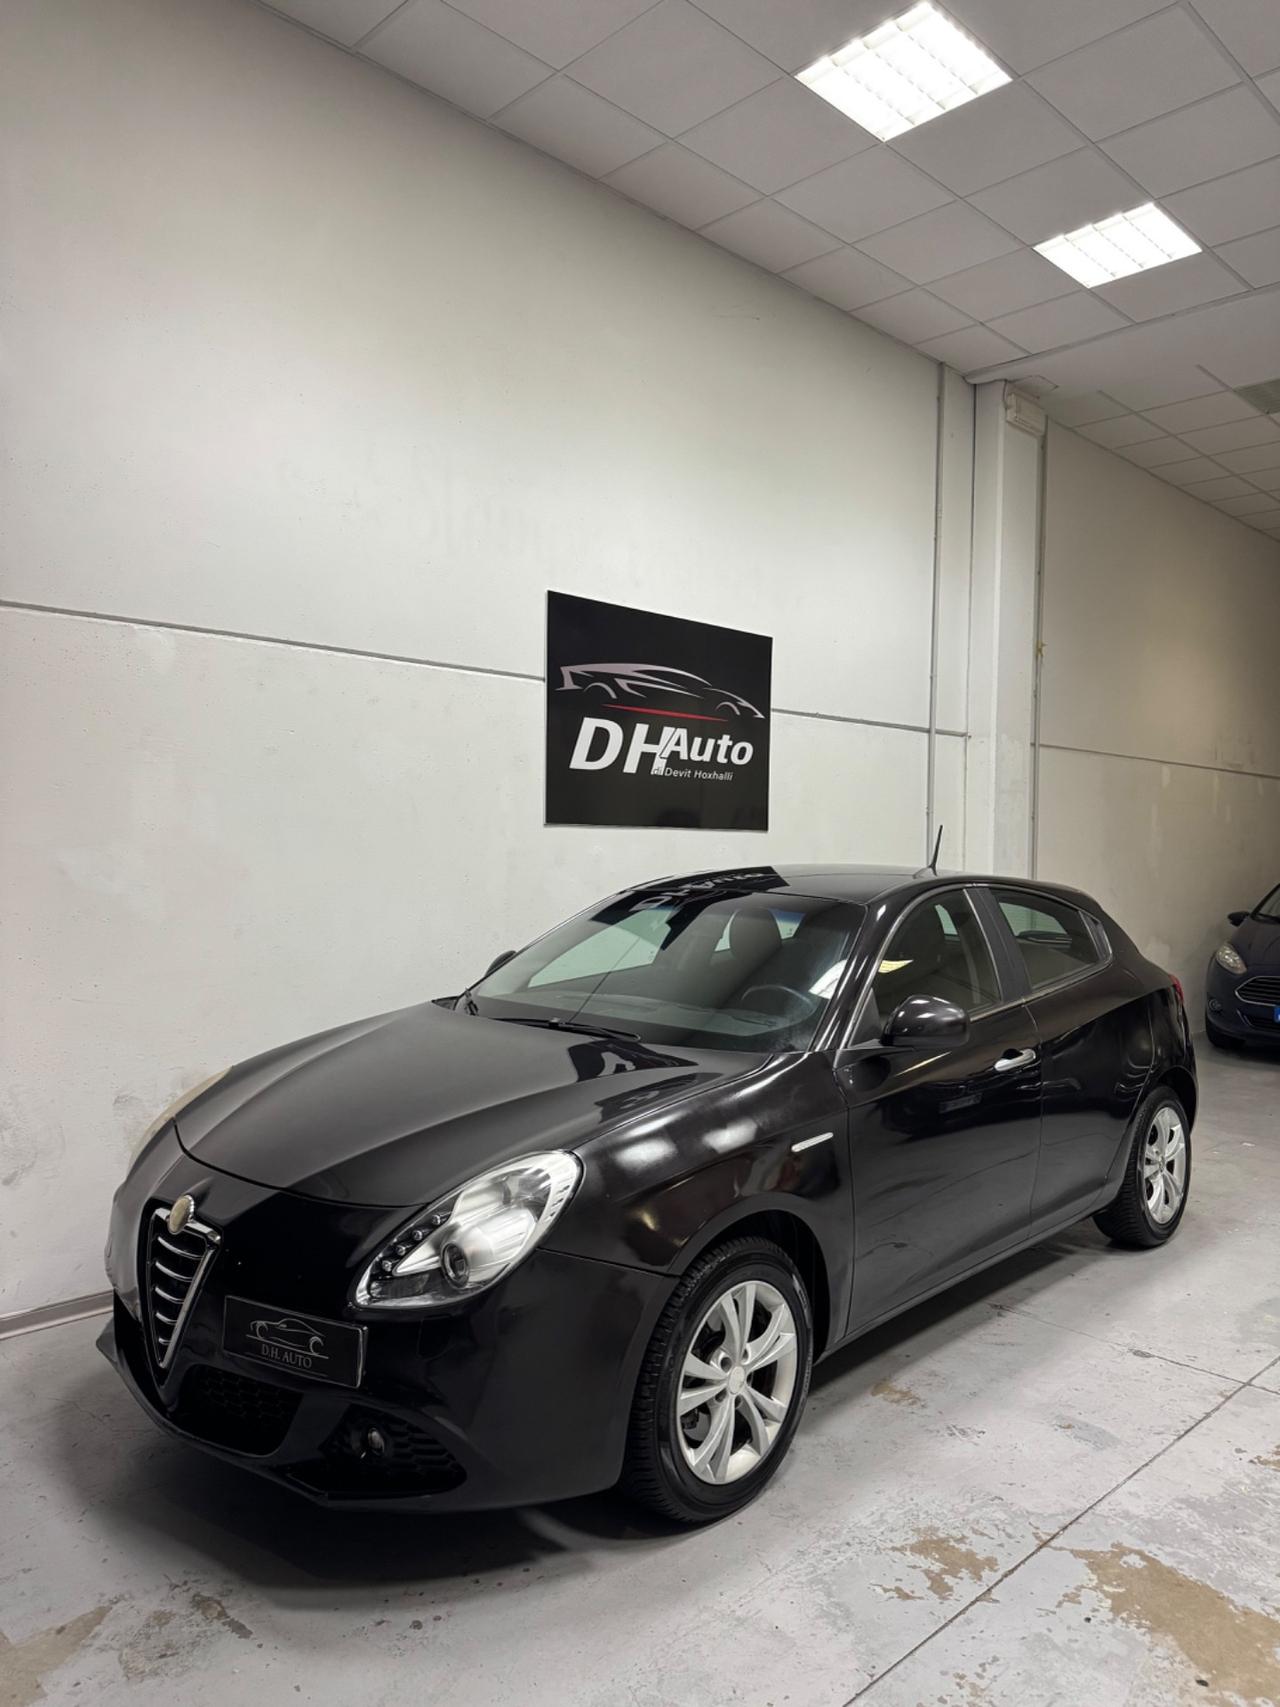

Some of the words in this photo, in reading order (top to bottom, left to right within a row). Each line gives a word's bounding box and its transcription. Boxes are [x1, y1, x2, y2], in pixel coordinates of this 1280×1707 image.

[664, 767, 691, 778] Devit
[693, 770, 734, 781] Hoxhalli
[282, 1351, 312, 1369] AUTO
